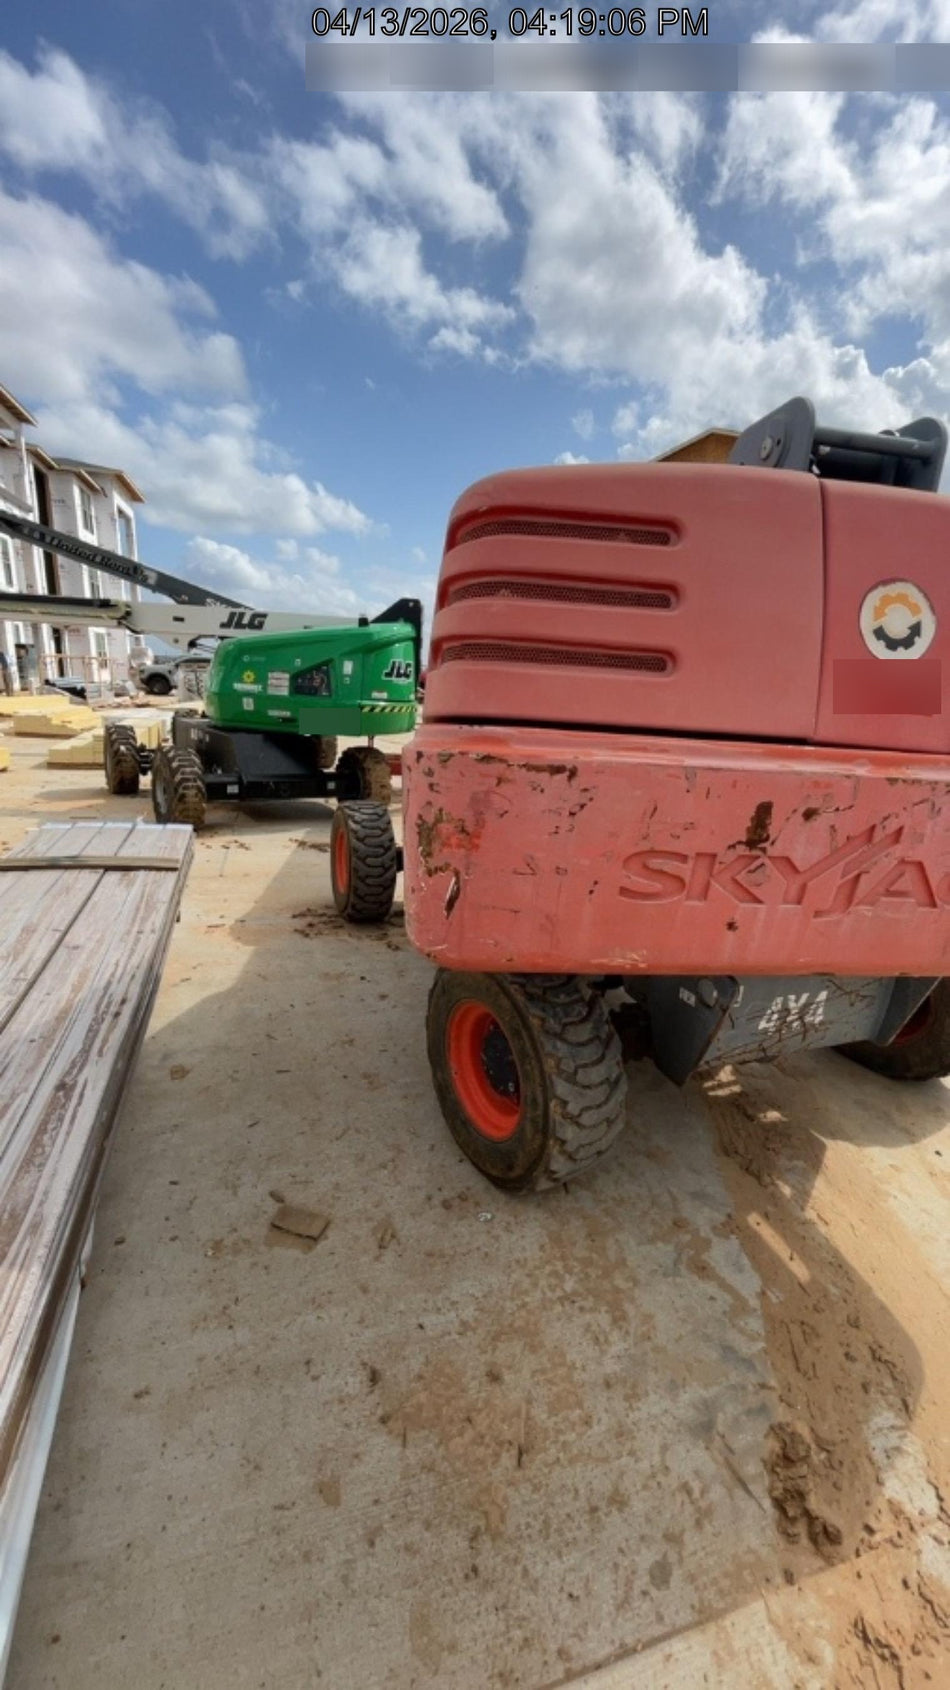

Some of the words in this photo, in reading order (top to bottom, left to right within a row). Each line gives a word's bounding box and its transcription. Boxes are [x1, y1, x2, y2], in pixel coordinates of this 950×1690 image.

[51, 537, 98, 562] United
[219, 611, 268, 631] JLG
[384, 660, 412, 680] JLG
[619, 824, 950, 919] SKYJA
